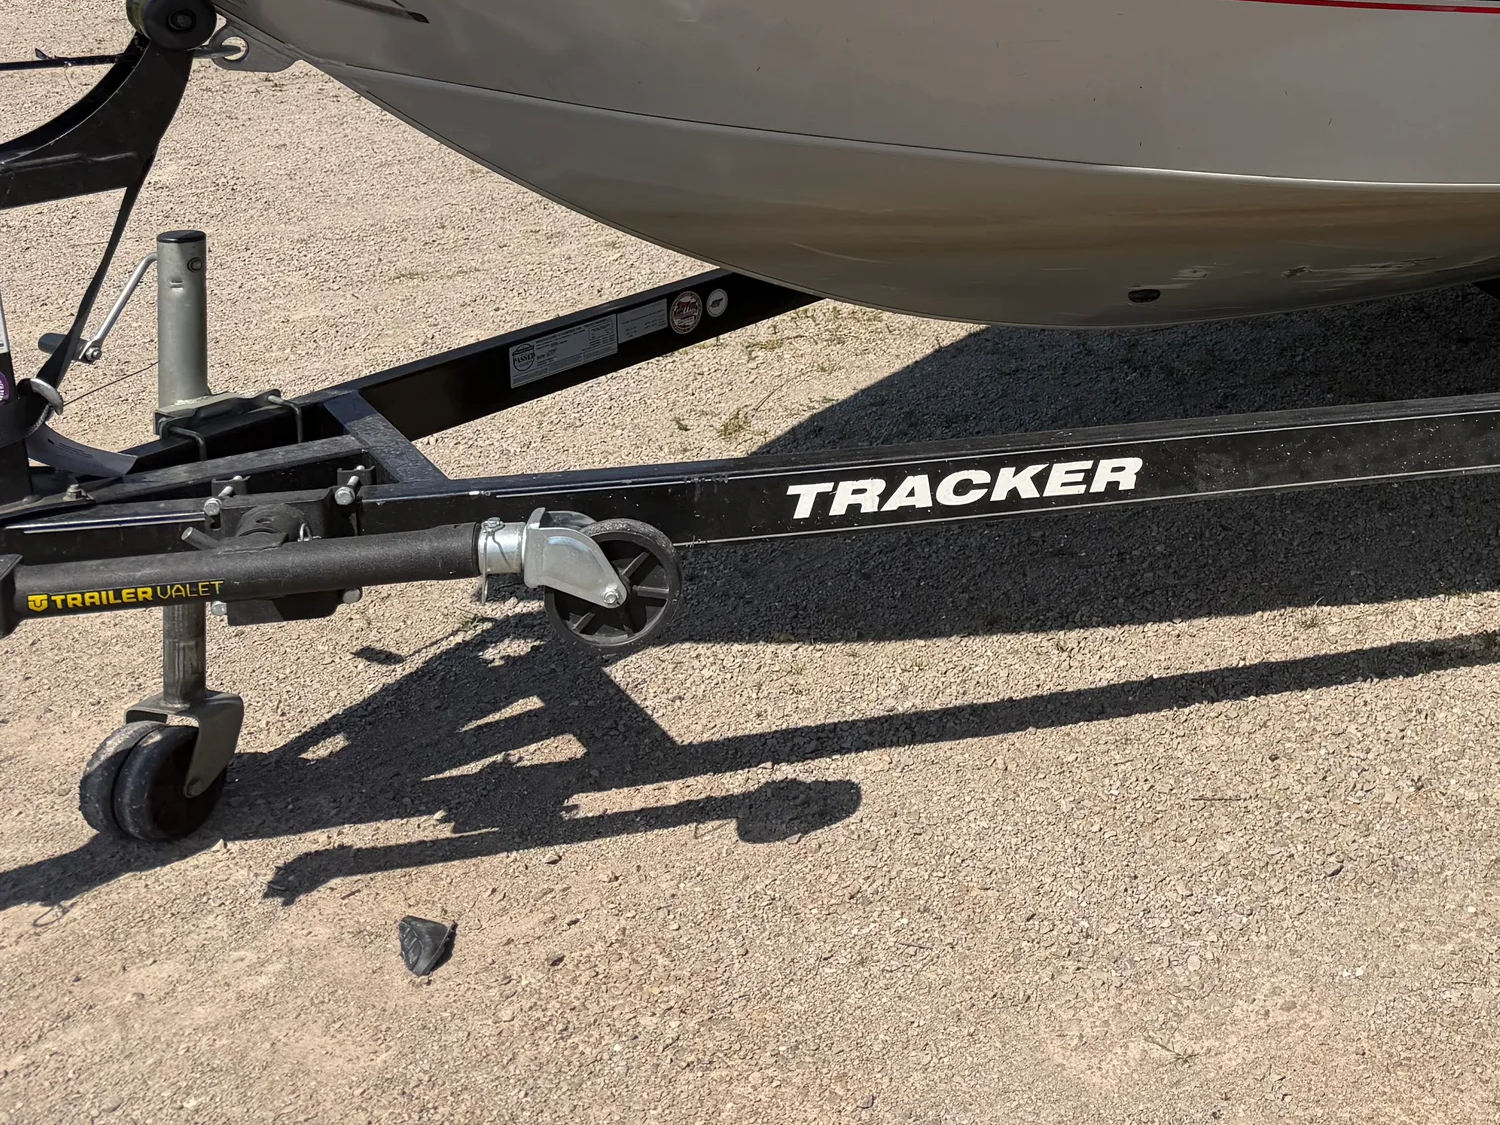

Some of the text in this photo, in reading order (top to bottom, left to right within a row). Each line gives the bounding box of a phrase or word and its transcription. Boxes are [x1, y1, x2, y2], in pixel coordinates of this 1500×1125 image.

[786, 457, 1143, 519] TRACKER
[51, 580, 224, 610] TRAILER VALET
